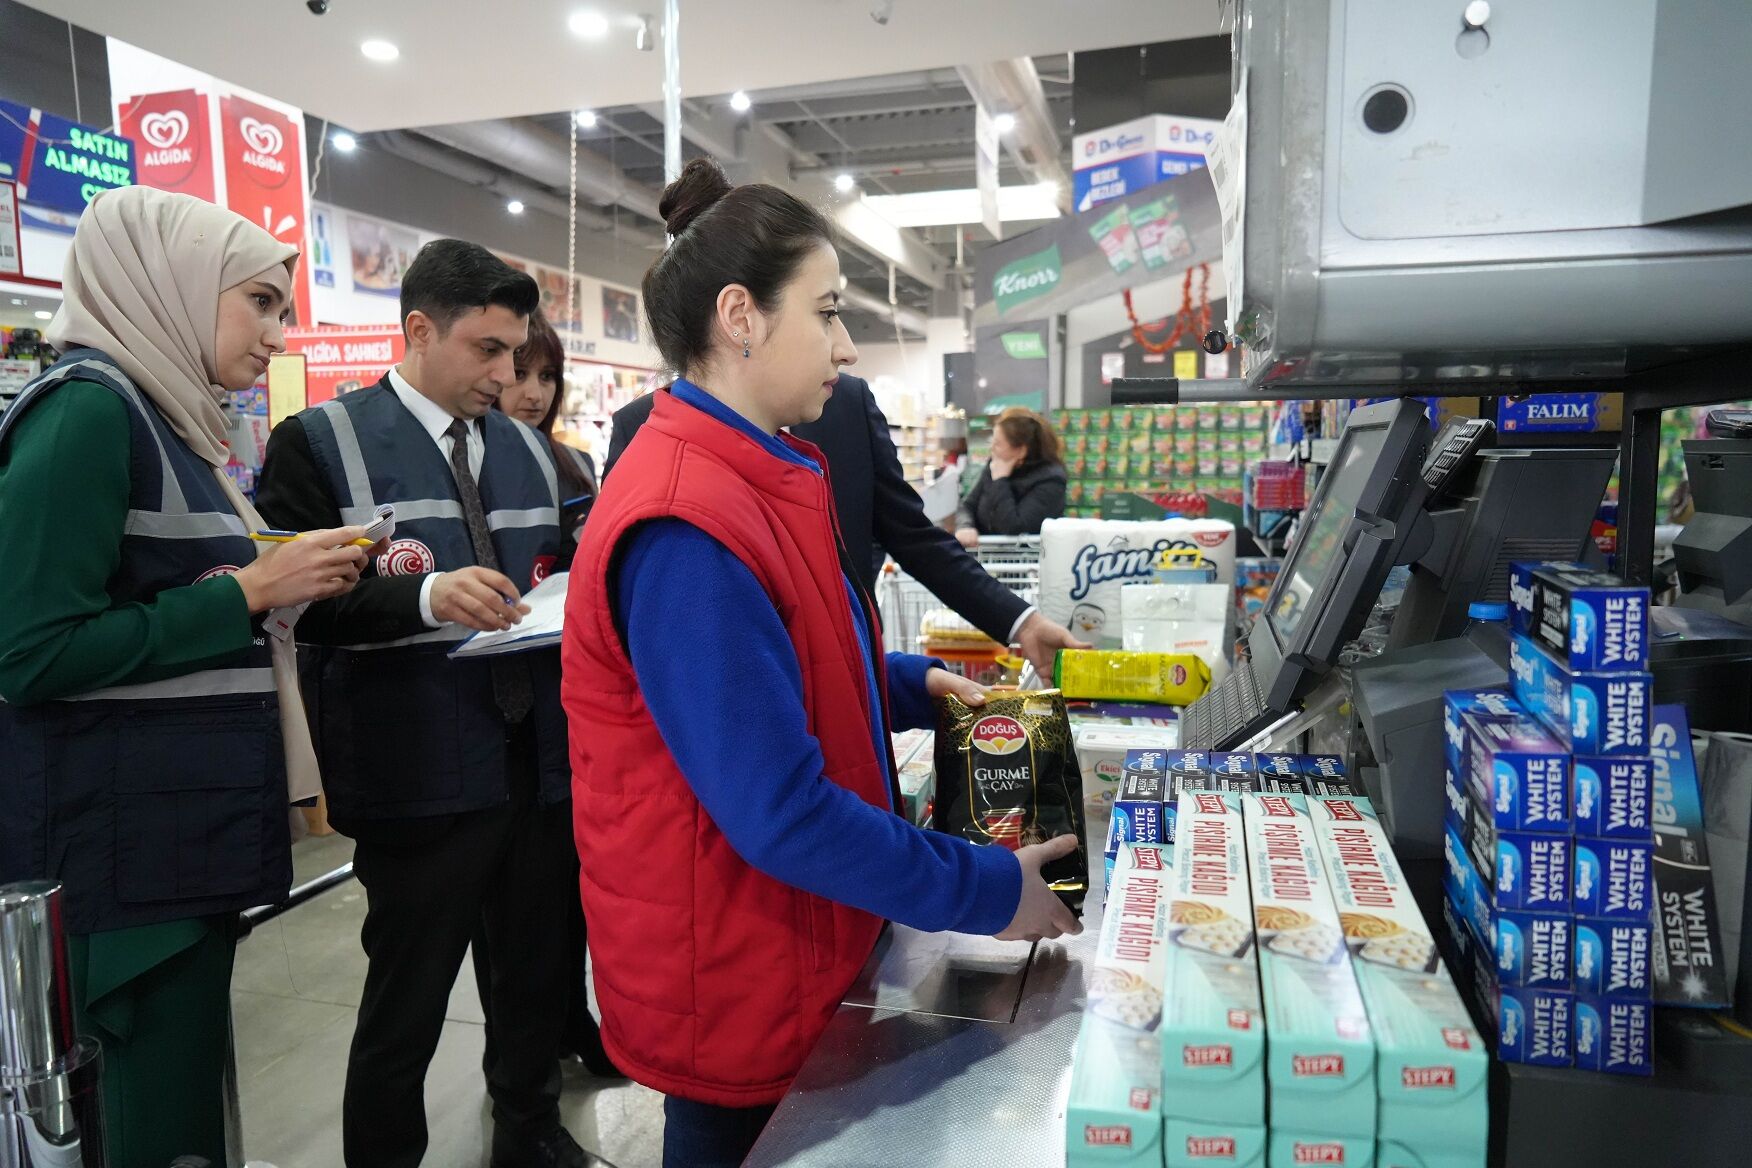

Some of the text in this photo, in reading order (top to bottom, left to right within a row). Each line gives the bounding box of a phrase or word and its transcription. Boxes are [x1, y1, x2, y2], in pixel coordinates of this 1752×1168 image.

[69, 128, 129, 162] SATIN
[45, 147, 132, 186] ALMASIZ
[993, 267, 1059, 297] Knorr
[1527, 403, 1589, 419] FALIM
[1572, 614, 1588, 655] Signal
[1602, 597, 1624, 665] WHITE
[1625, 597, 1641, 662] SYSTEM
[979, 723, 1019, 736] DOĞUŞ
[1573, 699, 1588, 739] Signal
[1604, 681, 1627, 750] WHITE
[1627, 681, 1644, 747] SYSTEM
[974, 766, 1030, 782] GURME
[1138, 752, 1161, 772] Signal
[1181, 752, 1204, 773] Signal
[1223, 754, 1248, 775] Signal
[1269, 756, 1295, 776] Signal
[1315, 757, 1341, 776] Signal
[990, 780, 1015, 794] ÇAY
[1196, 794, 1225, 814] STEPY
[1262, 796, 1295, 816] STEPY
[1496, 774, 1512, 814] Signal
[1525, 759, 1546, 824] WHITE
[1547, 758, 1562, 822] SYSTEM
[1577, 778, 1591, 819] Signal
[1606, 764, 1629, 831] WHITE
[1629, 764, 1646, 830] SYSTEM
[1116, 816, 1126, 842] Signal
[1168, 818, 1176, 842] Signal
[1326, 800, 1360, 820] STEPY
[1136, 848, 1160, 870] STEPY
[1187, 820, 1237, 896] PİŞİRME KAĞIDI
[1259, 823, 1318, 901] PİŞİRME KAĞIDI
[1329, 827, 1398, 908] PİŞİRME KAĞIDI
[1499, 853, 1513, 892] Signal
[1527, 840, 1549, 904] WHITE
[1549, 840, 1565, 902] SYSTEM
[1576, 860, 1591, 900] Signal
[1605, 848, 1628, 912] WHITE
[1628, 848, 1646, 911] SYSTEM
[1115, 877, 1164, 963] PİŞİRME KAĞIDI
[1662, 891, 1688, 967] SYSTEM
[1683, 887, 1713, 968] WHITE
[1499, 932, 1513, 971] Signal
[1528, 920, 1550, 983] WHITE
[1550, 920, 1567, 981] SYSTEM
[1577, 940, 1592, 979] Signal
[1607, 926, 1630, 991] WHITE
[1629, 927, 1647, 989] SYSTEM
[1502, 1007, 1516, 1046] Signal
[1531, 997, 1551, 1059] WHITE
[1552, 997, 1568, 1058] SYSTEM
[1578, 1016, 1591, 1054] Signal
[1607, 1003, 1628, 1067] WHITE
[1629, 1004, 1645, 1066] SYSTEM
